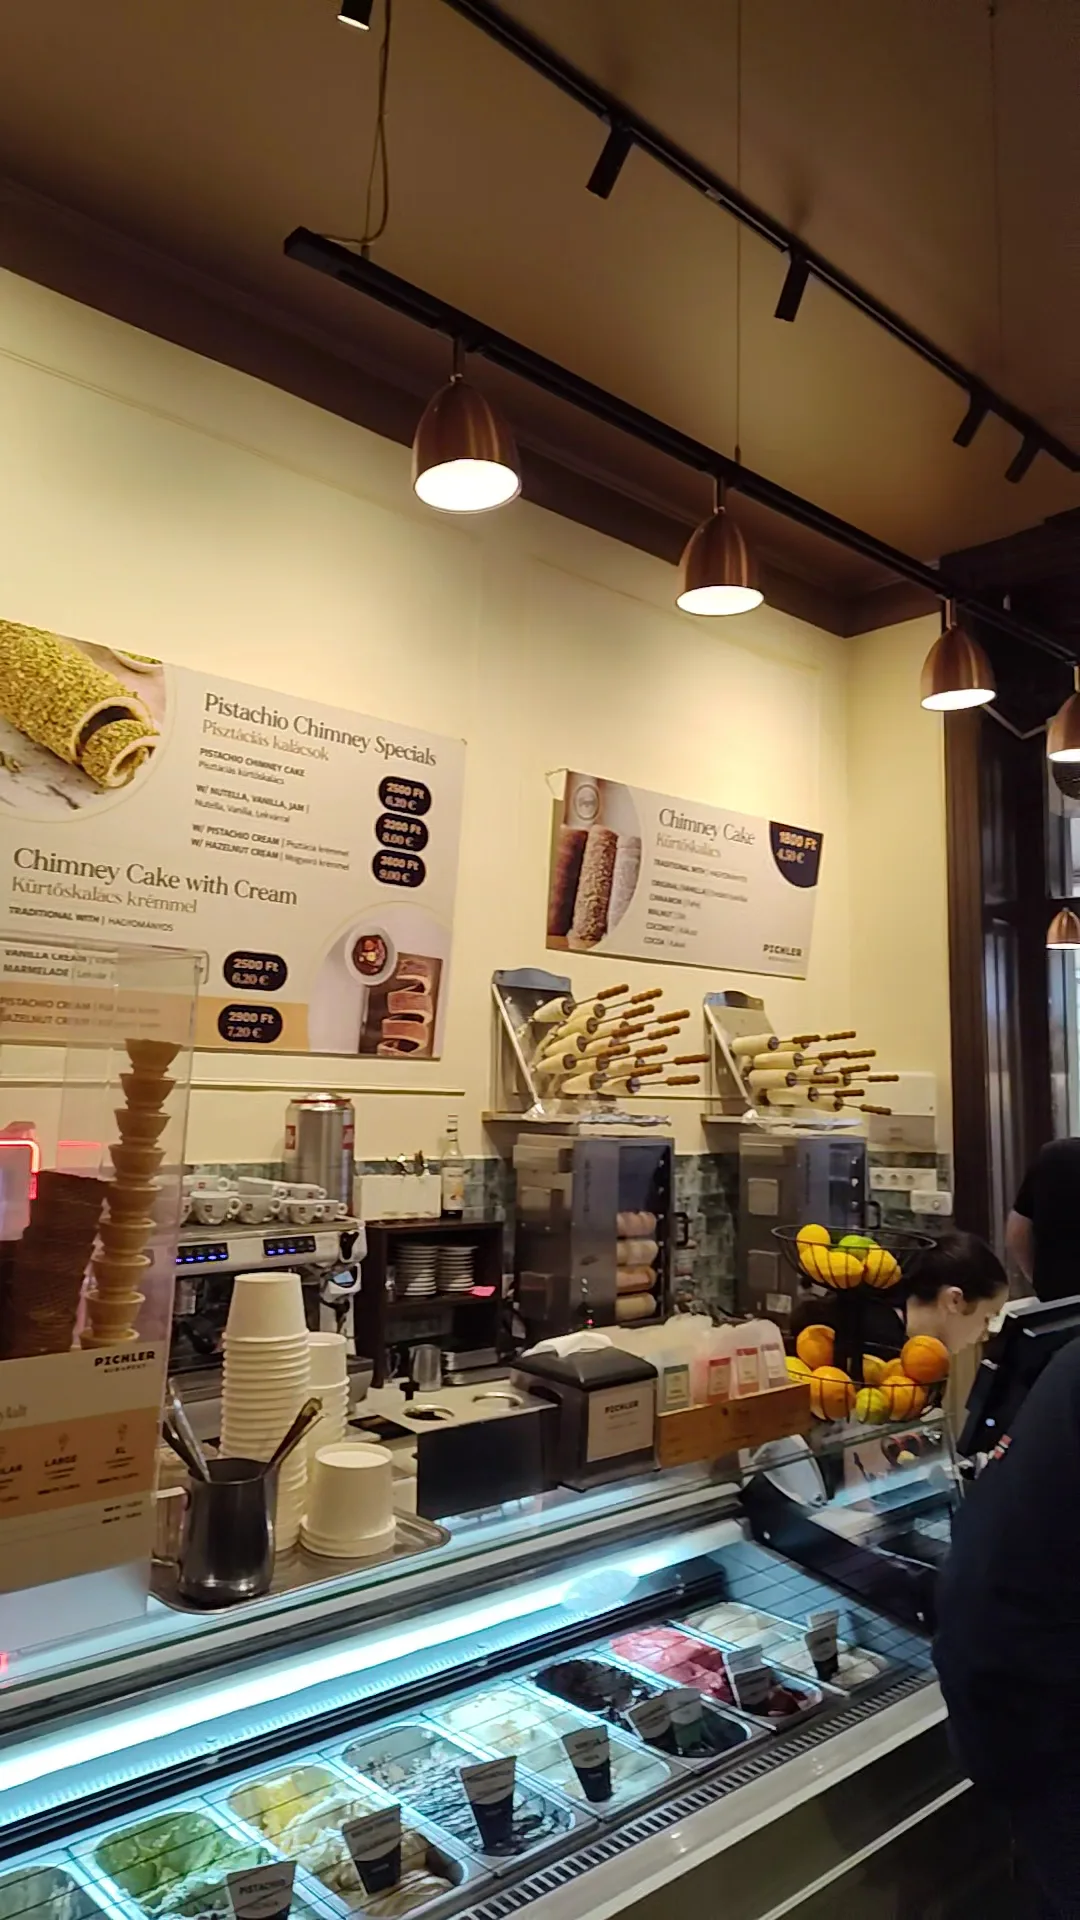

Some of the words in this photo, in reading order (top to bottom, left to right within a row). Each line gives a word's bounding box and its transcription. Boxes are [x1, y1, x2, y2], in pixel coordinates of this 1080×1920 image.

[205, 692, 289, 730] Pistachio
[293, 715, 371, 754] Chimney
[374, 735, 437, 766] Specials
[272, 735, 329, 761] kalácsok
[200, 747, 244, 764] PISTACHIO
[245, 757, 282, 772] CHIMNEY
[283, 765, 306, 777] CAKE
[210, 787, 250, 802] NUTELLA,
[251, 794, 287, 810] VANILLA,
[288, 802, 305, 812] JAM
[412, 787, 425, 800] Ft
[408, 800, 417, 811] €
[409, 823, 422, 835] Ft
[659, 808, 718, 841] Chimney
[723, 823, 756, 846] Cake
[206, 826, 250, 841] PISTACHIO
[251, 833, 280, 846] CREAM
[804, 836, 817, 851] Ft
[204, 841, 249, 854] HAZELNUT
[250, 847, 279, 859] CREAM
[406, 859, 420, 871] Ft
[13, 847, 120, 885] Chimney
[126, 863, 181, 889] Cake
[185, 875, 228, 896] with
[234, 879, 298, 906] Cream
[126, 890, 198, 914] krémmel
[9, 905, 73, 921] TRADITIONAL
[75, 913, 100, 924] WITH
[4, 949, 49, 960] VANILLA
[763, 943, 803, 957] PICHLER
[3, 963, 69, 977] MARMELADE
[232, 957, 263, 971] 2500
[265, 960, 279, 973] Ft
[258, 974, 270, 986] €
[260, 1012, 274, 1024] Ft
[251, 1026, 263, 1039] €
[94, 1350, 156, 1367] PICHLER
